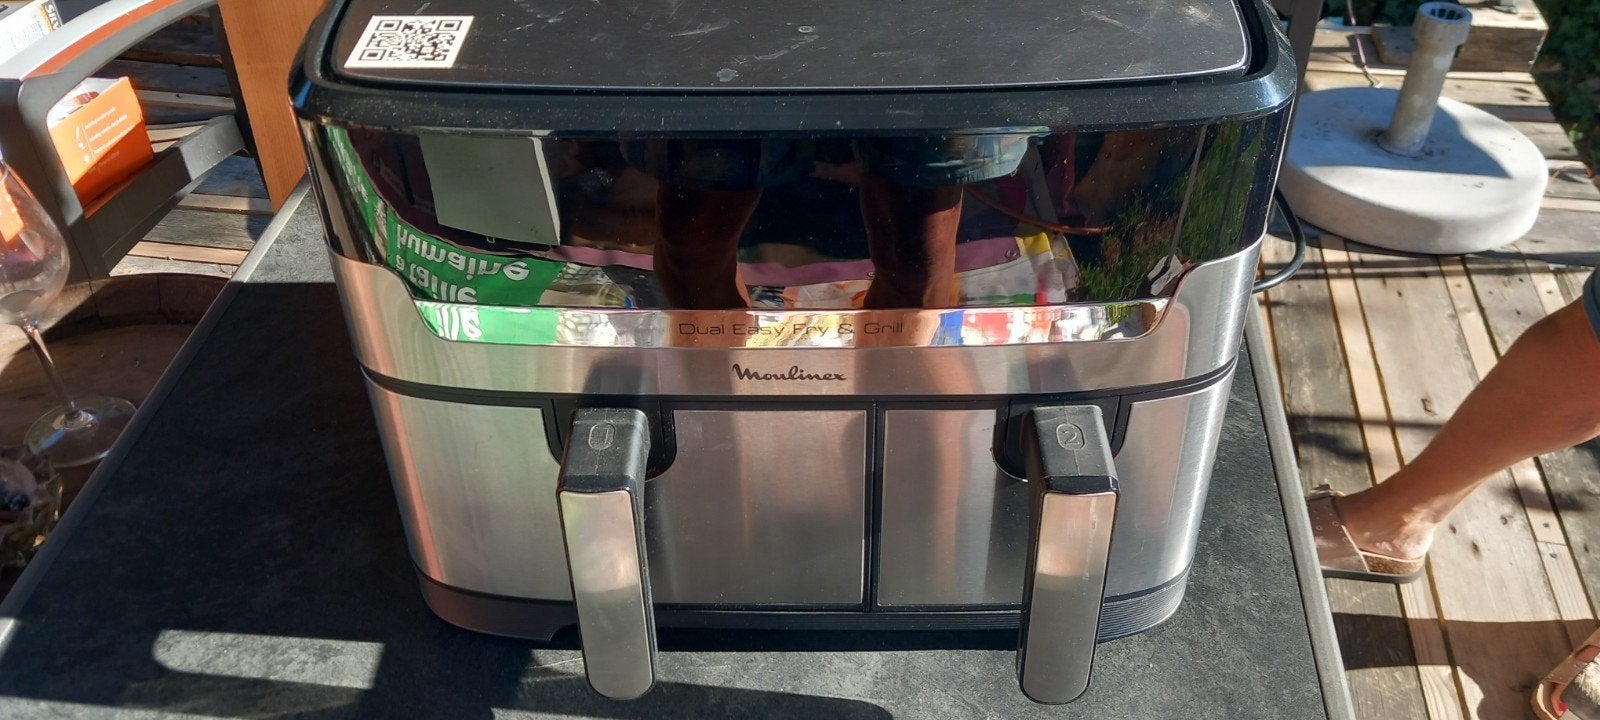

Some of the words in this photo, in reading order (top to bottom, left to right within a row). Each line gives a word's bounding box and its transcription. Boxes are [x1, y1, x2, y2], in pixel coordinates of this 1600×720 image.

[679, 323, 725, 335] Dual
[732, 323, 785, 337] Easy
[793, 323, 829, 337] Fry
[837, 323, 855, 335] &
[863, 322, 904, 335] Grill
[732, 363, 847, 381] Moulinex
[1062, 429, 1079, 445] 2
